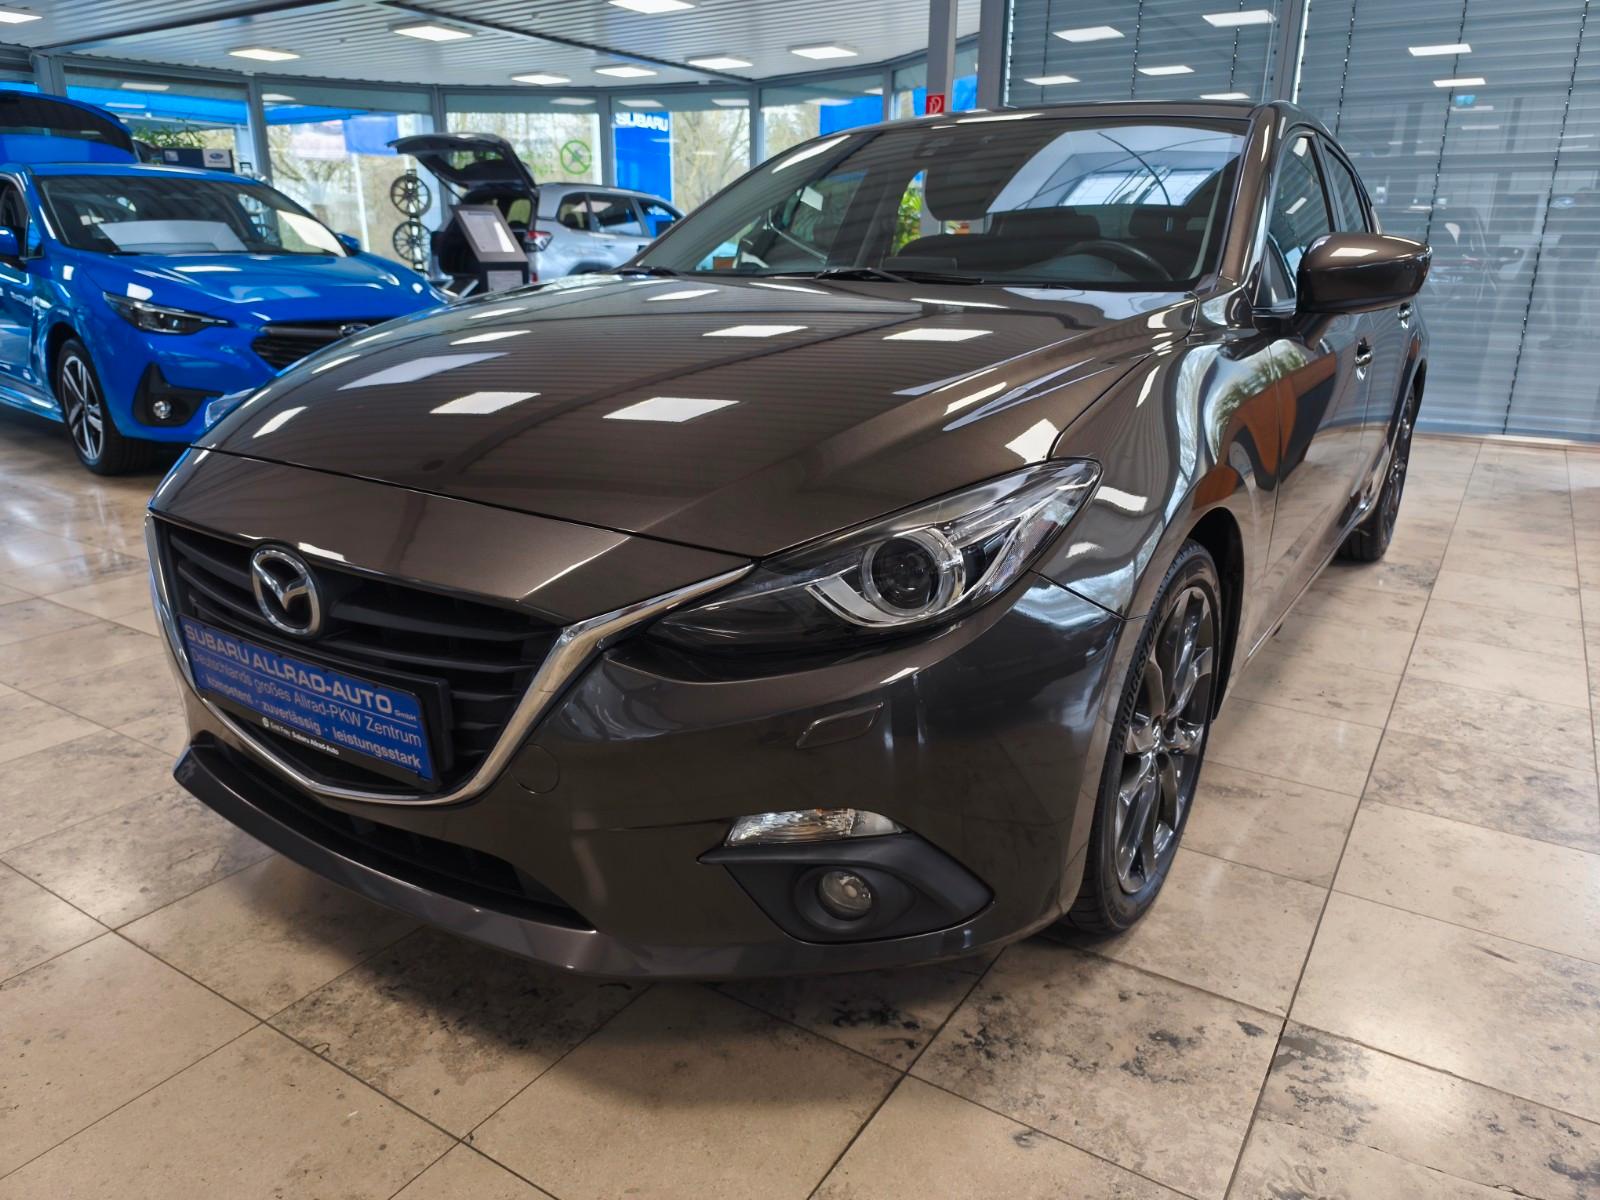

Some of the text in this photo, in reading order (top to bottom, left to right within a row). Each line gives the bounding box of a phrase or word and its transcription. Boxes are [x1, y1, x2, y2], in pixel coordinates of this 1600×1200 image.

[615, 112, 669, 132] SUBARU
[184, 624, 250, 665] SUBARU
[253, 653, 393, 714] ALLRAD-AUTO
[254, 679, 292, 702] großes
[294, 690, 361, 727] Allrad-PKW
[364, 715, 422, 748] Zentrum
[263, 701, 321, 736] zuverlässig
[332, 726, 422, 769] leistungsstark
